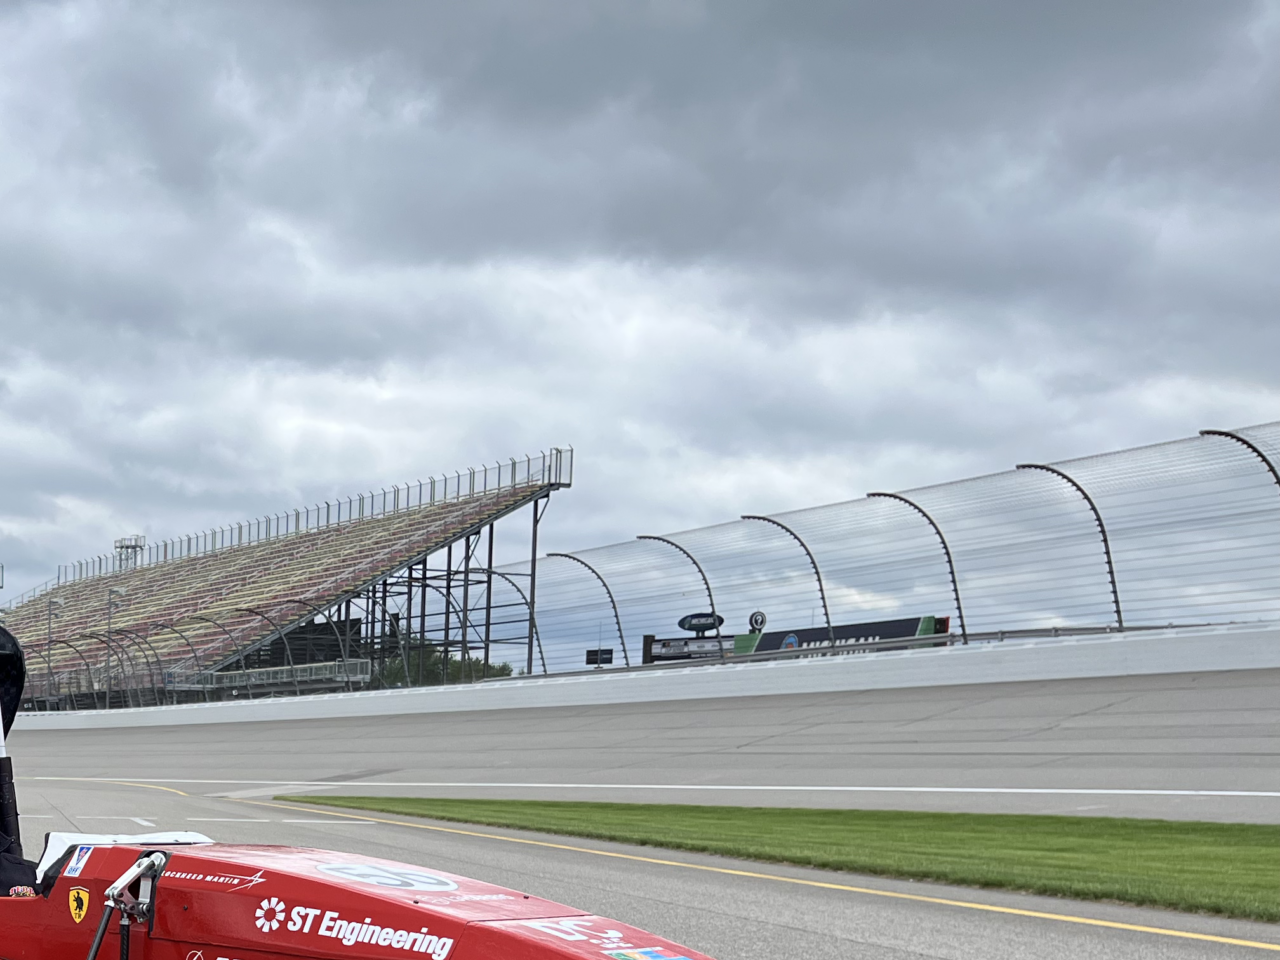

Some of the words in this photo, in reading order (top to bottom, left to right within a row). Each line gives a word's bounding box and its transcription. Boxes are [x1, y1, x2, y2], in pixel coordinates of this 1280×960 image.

[161, 870, 203, 880] LOCKHEED
[204, 875, 240, 885] MARTIN
[287, 906, 320, 933] ST
[318, 911, 454, 960] Engineering
